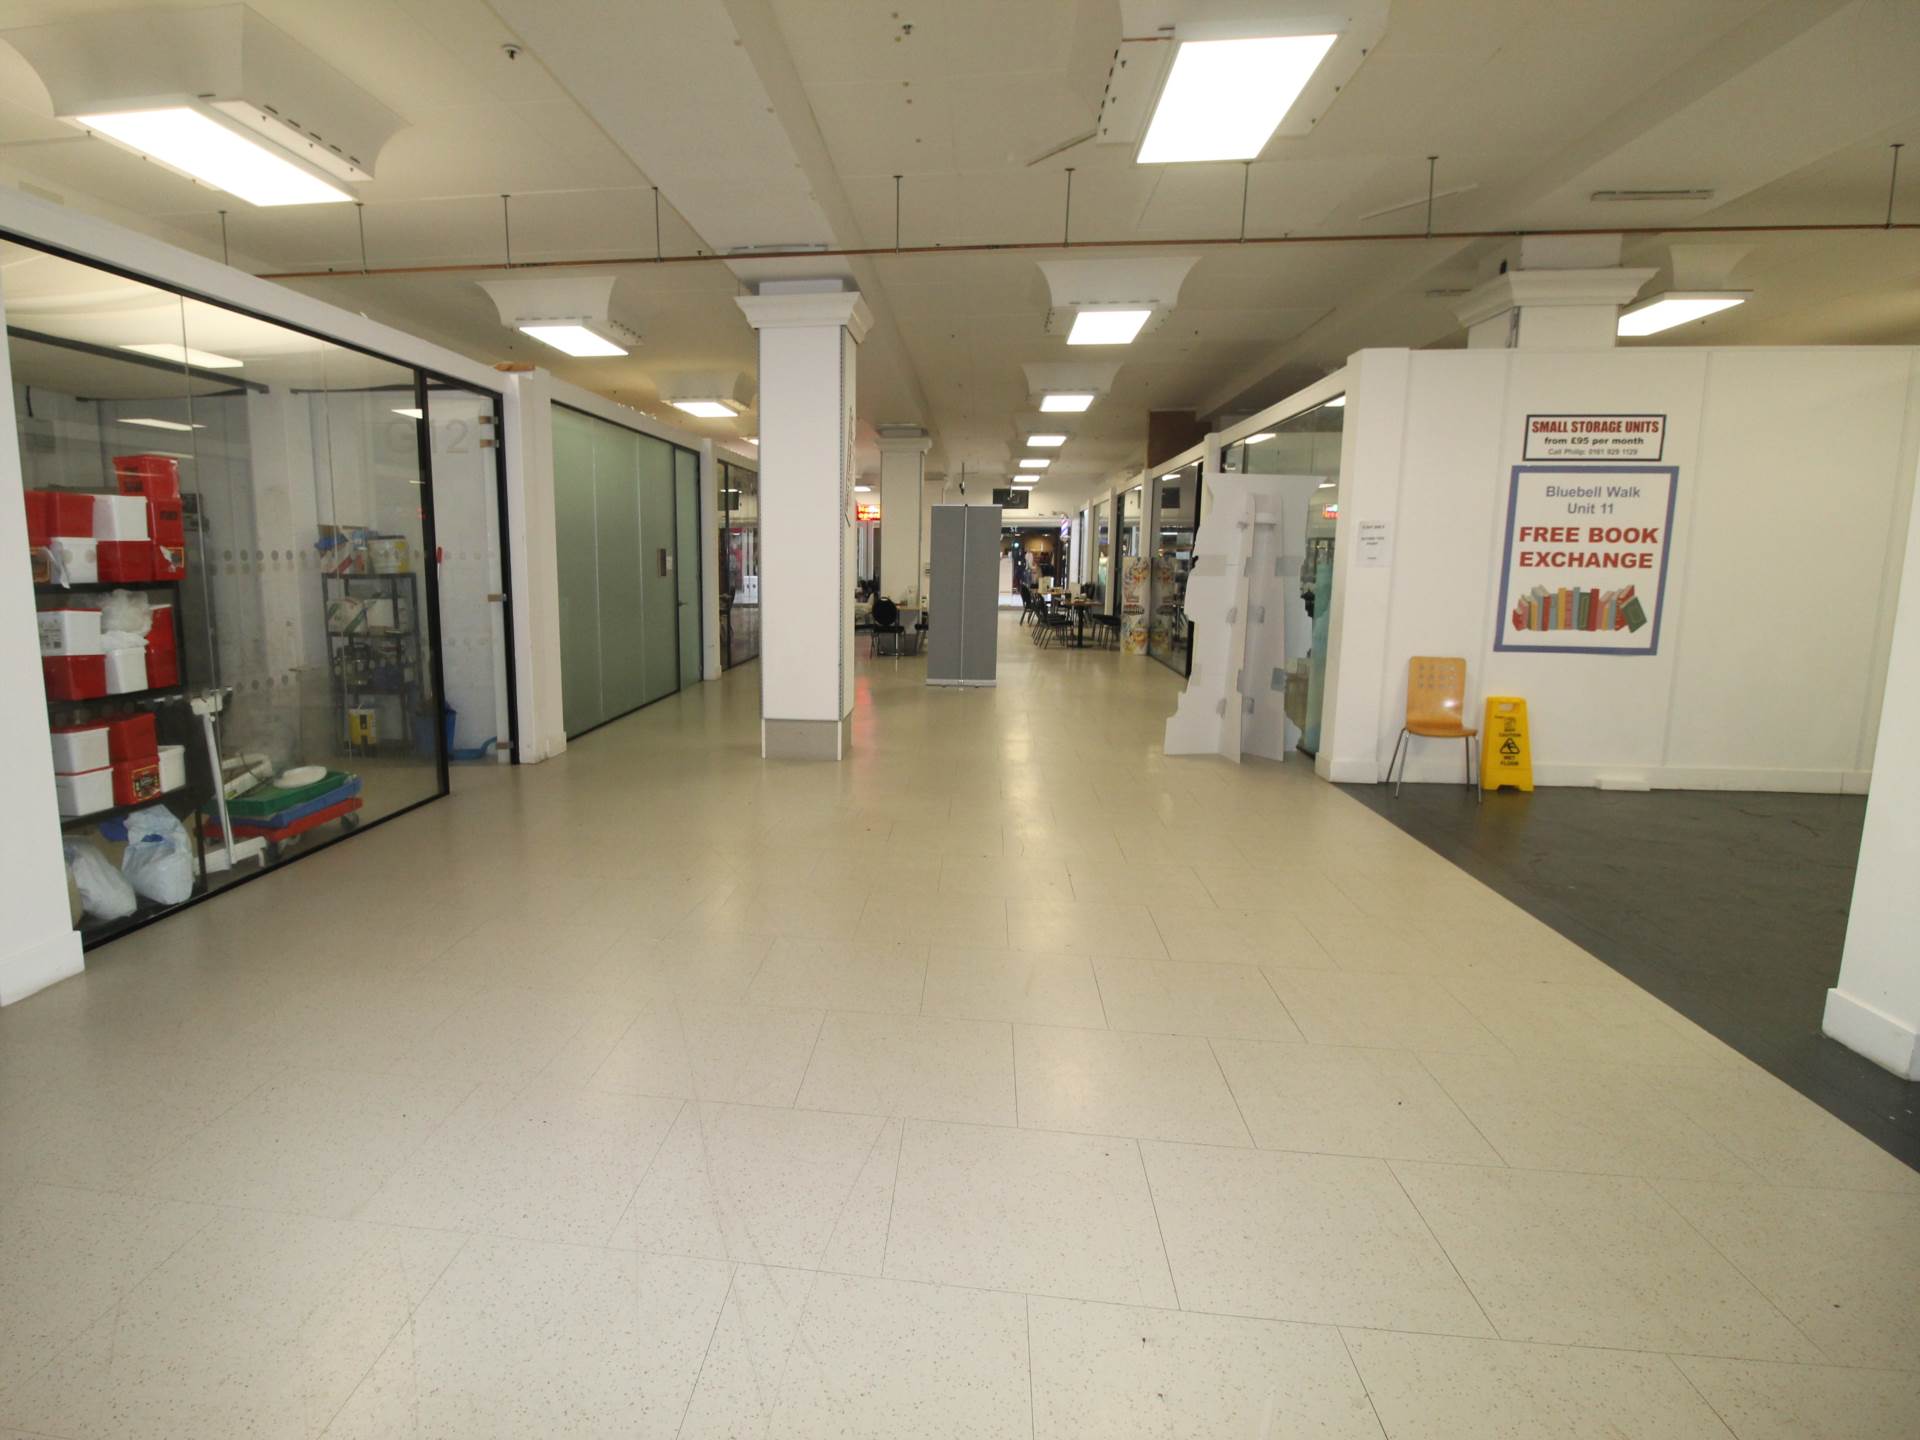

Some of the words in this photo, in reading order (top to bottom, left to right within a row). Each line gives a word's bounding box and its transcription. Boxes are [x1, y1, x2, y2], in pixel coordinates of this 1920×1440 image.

[1532, 421, 1568, 433] SMALL
[1571, 421, 1622, 433] STORAGE
[1625, 421, 1659, 433] UNITS
[1544, 437, 1567, 445] from
[1570, 437, 1589, 445] £95
[1591, 438, 1608, 446] per
[1611, 437, 1644, 445] month
[1545, 486, 1602, 498] Bluebell
[1606, 486, 1641, 498] Walk
[1567, 503, 1596, 515] Unit
[1601, 503, 1614, 515] 11
[1519, 526, 1580, 543] FREE
[1588, 527, 1659, 544] BOOK
[1519, 551, 1654, 569] EXCHANGE
